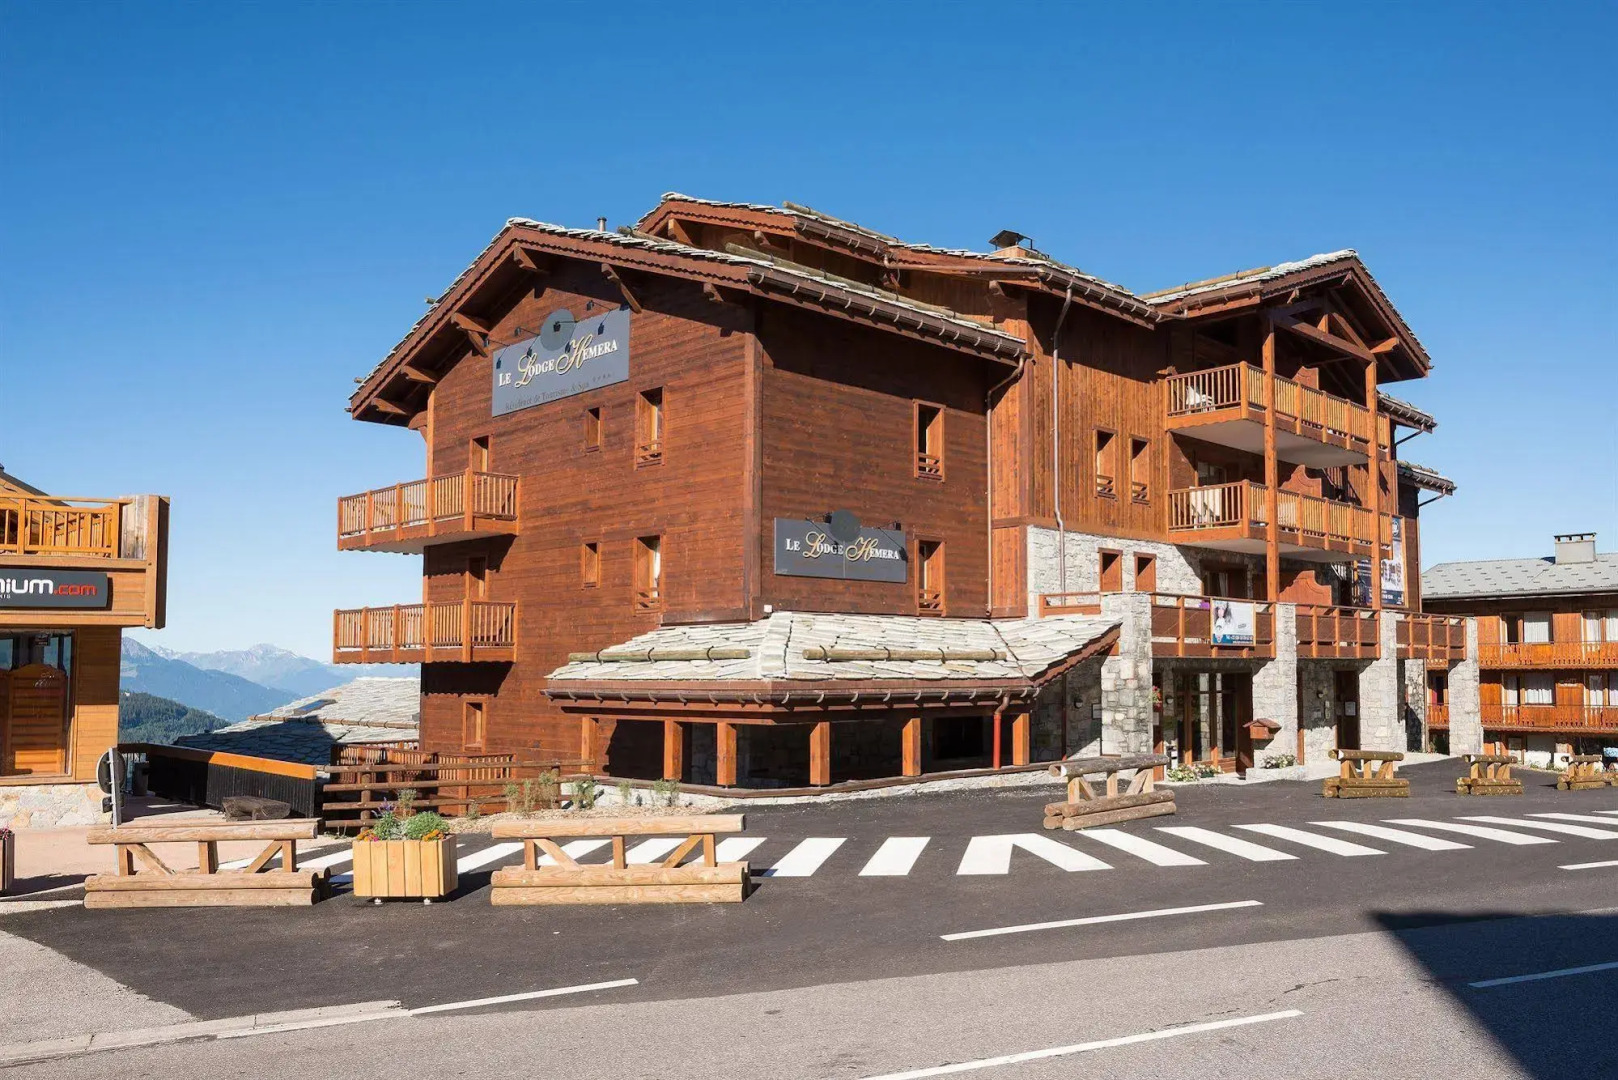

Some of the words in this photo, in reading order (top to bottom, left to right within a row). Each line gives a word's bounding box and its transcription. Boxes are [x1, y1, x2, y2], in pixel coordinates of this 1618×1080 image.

[498, 372, 511, 387] LE
[514, 352, 556, 388] LODGE
[785, 538, 801, 551] LE
[802, 531, 844, 558] LODGE
